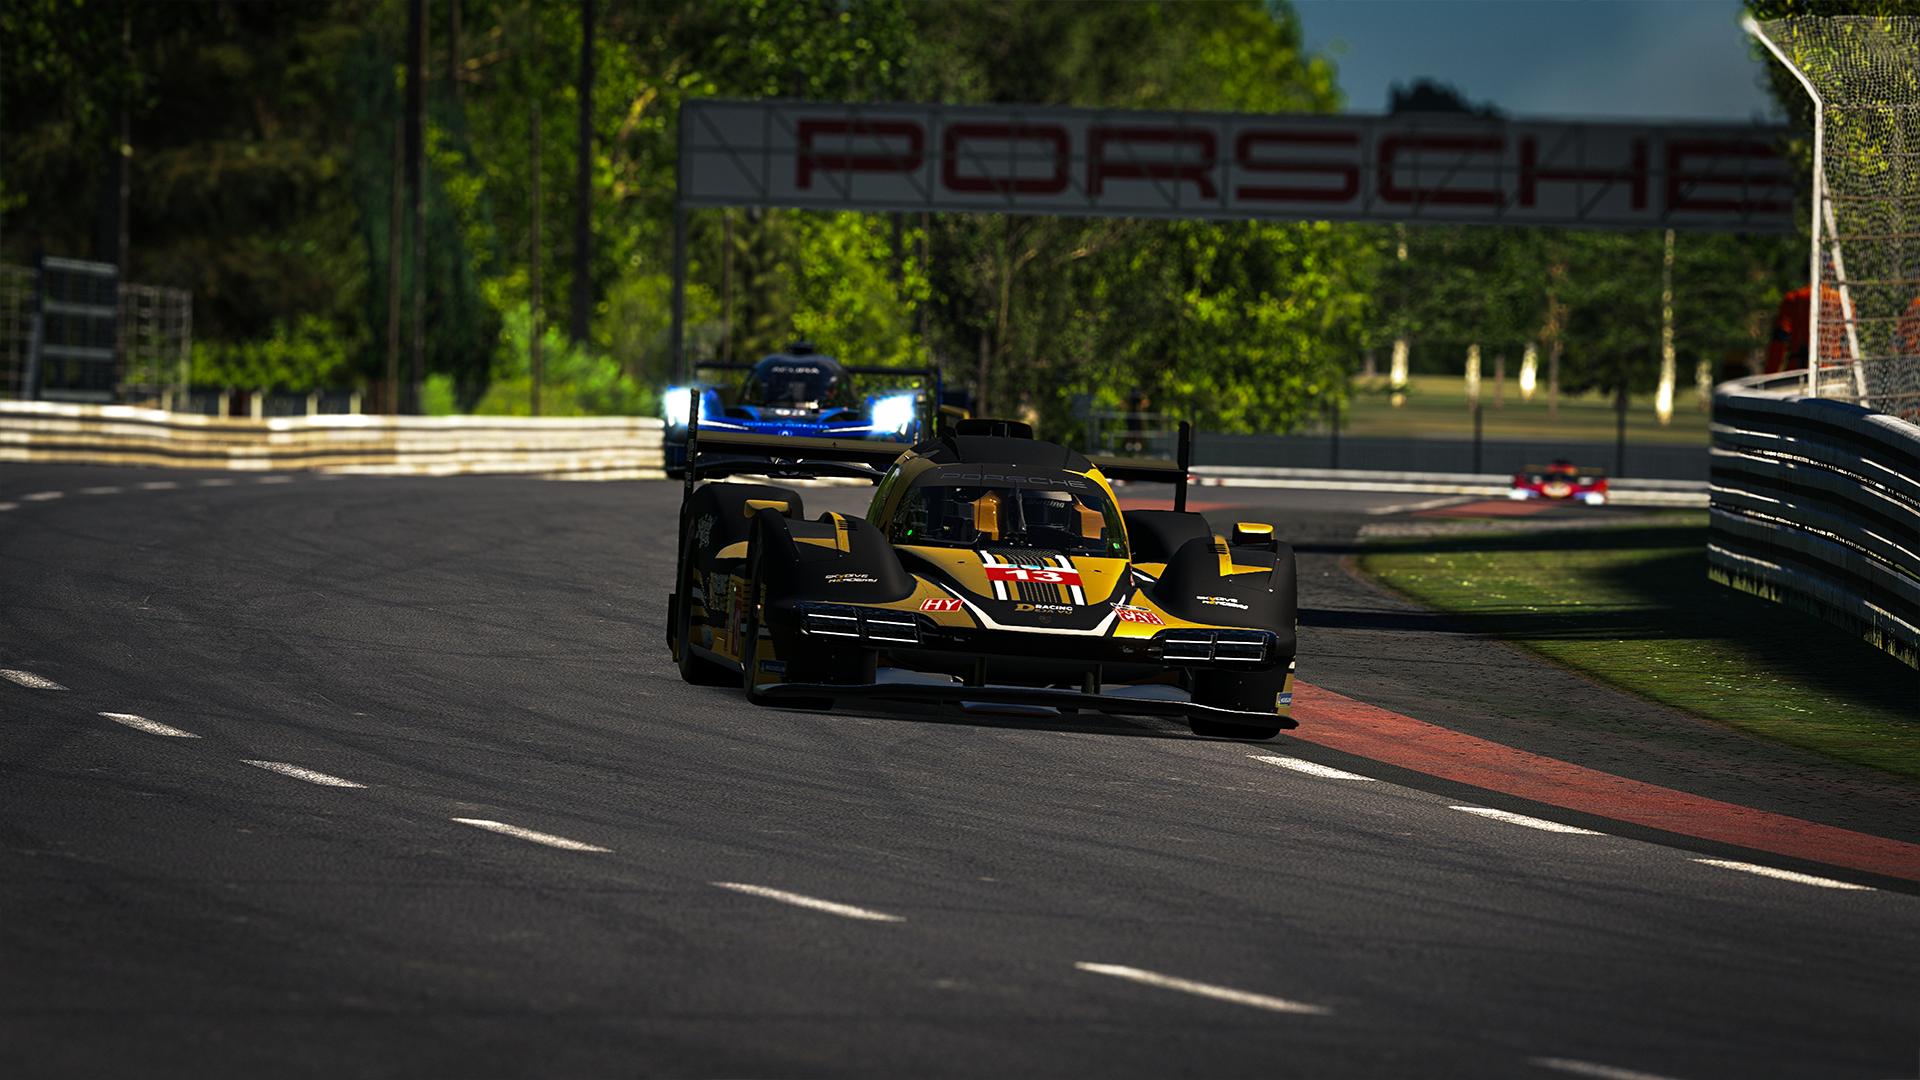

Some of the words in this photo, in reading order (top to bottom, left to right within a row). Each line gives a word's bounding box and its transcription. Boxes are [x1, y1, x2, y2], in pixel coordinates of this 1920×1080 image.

[796, 119, 1790, 213] PORSCHE
[940, 473, 1088, 488] PORSCHE
[1005, 569, 1063, 582] 13
[924, 599, 961, 610] HY
